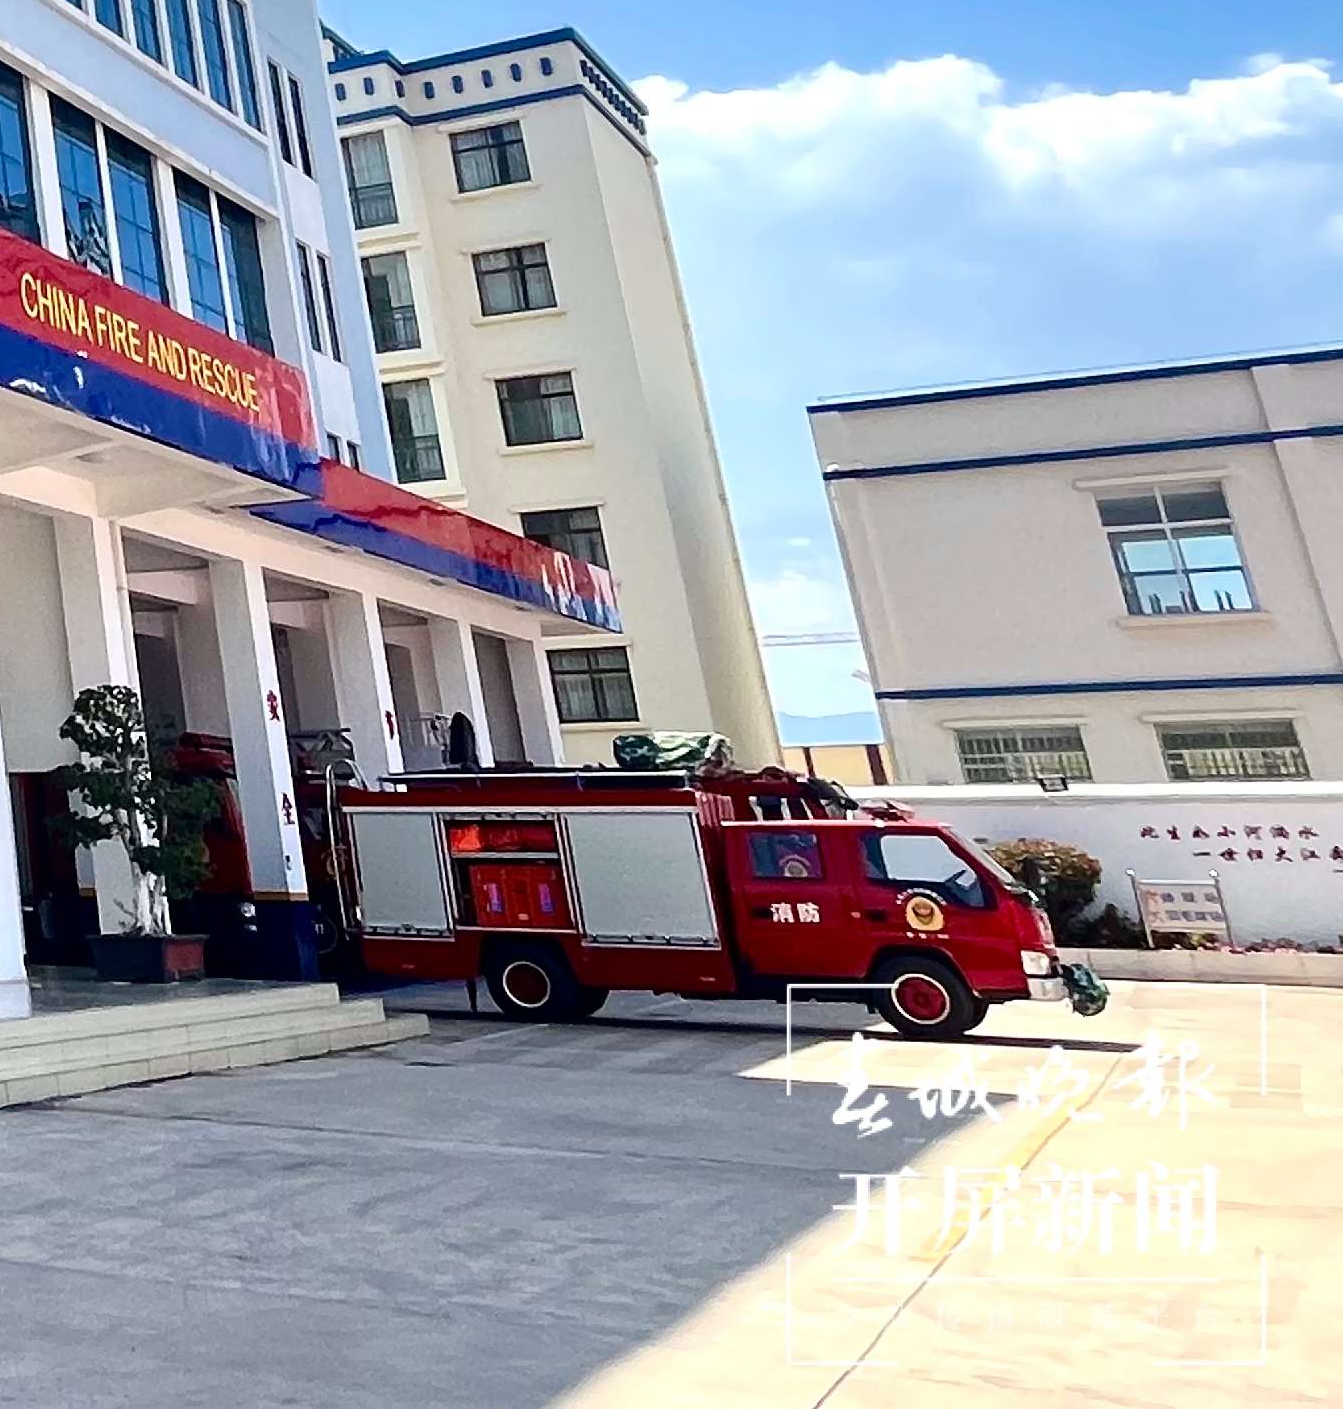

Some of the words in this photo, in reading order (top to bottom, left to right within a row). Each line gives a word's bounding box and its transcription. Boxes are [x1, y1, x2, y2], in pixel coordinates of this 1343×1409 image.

[20, 272, 93, 343] CHINA
[94, 305, 143, 363] FIRE
[148, 330, 187, 381] AND
[188, 347, 260, 412] RESCUE
[769, 902, 820, 923] 消防
